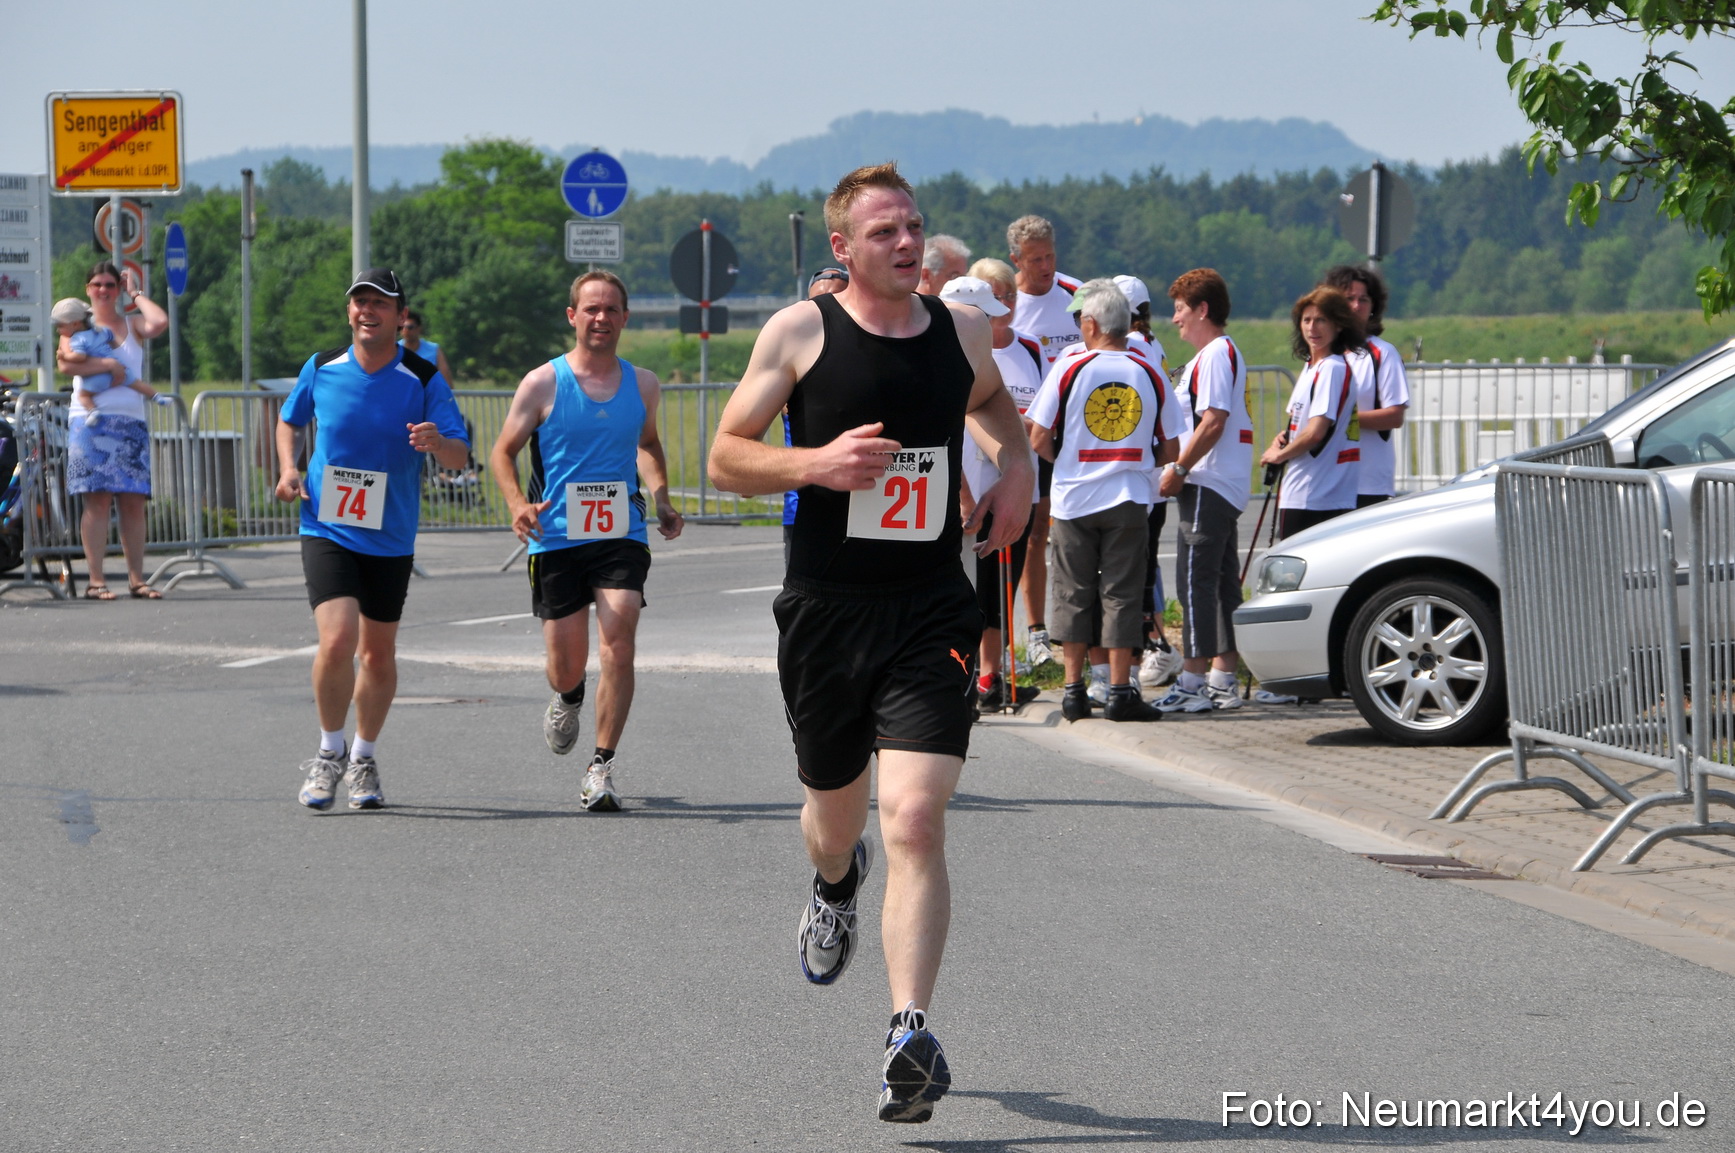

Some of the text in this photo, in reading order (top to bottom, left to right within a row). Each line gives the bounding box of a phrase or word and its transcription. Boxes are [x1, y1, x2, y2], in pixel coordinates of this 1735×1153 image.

[64, 108, 166, 138] Sengenthal
[78, 139, 152, 155] am Anger
[89, 165, 134, 176] Neumarkt
[333, 469, 362, 479] MEYER
[884, 463, 916, 472] RBUNG
[333, 477, 362, 485] WERBUNG
[336, 485, 367, 521] 74
[880, 475, 928, 530] 21
[580, 500, 614, 533] 75
